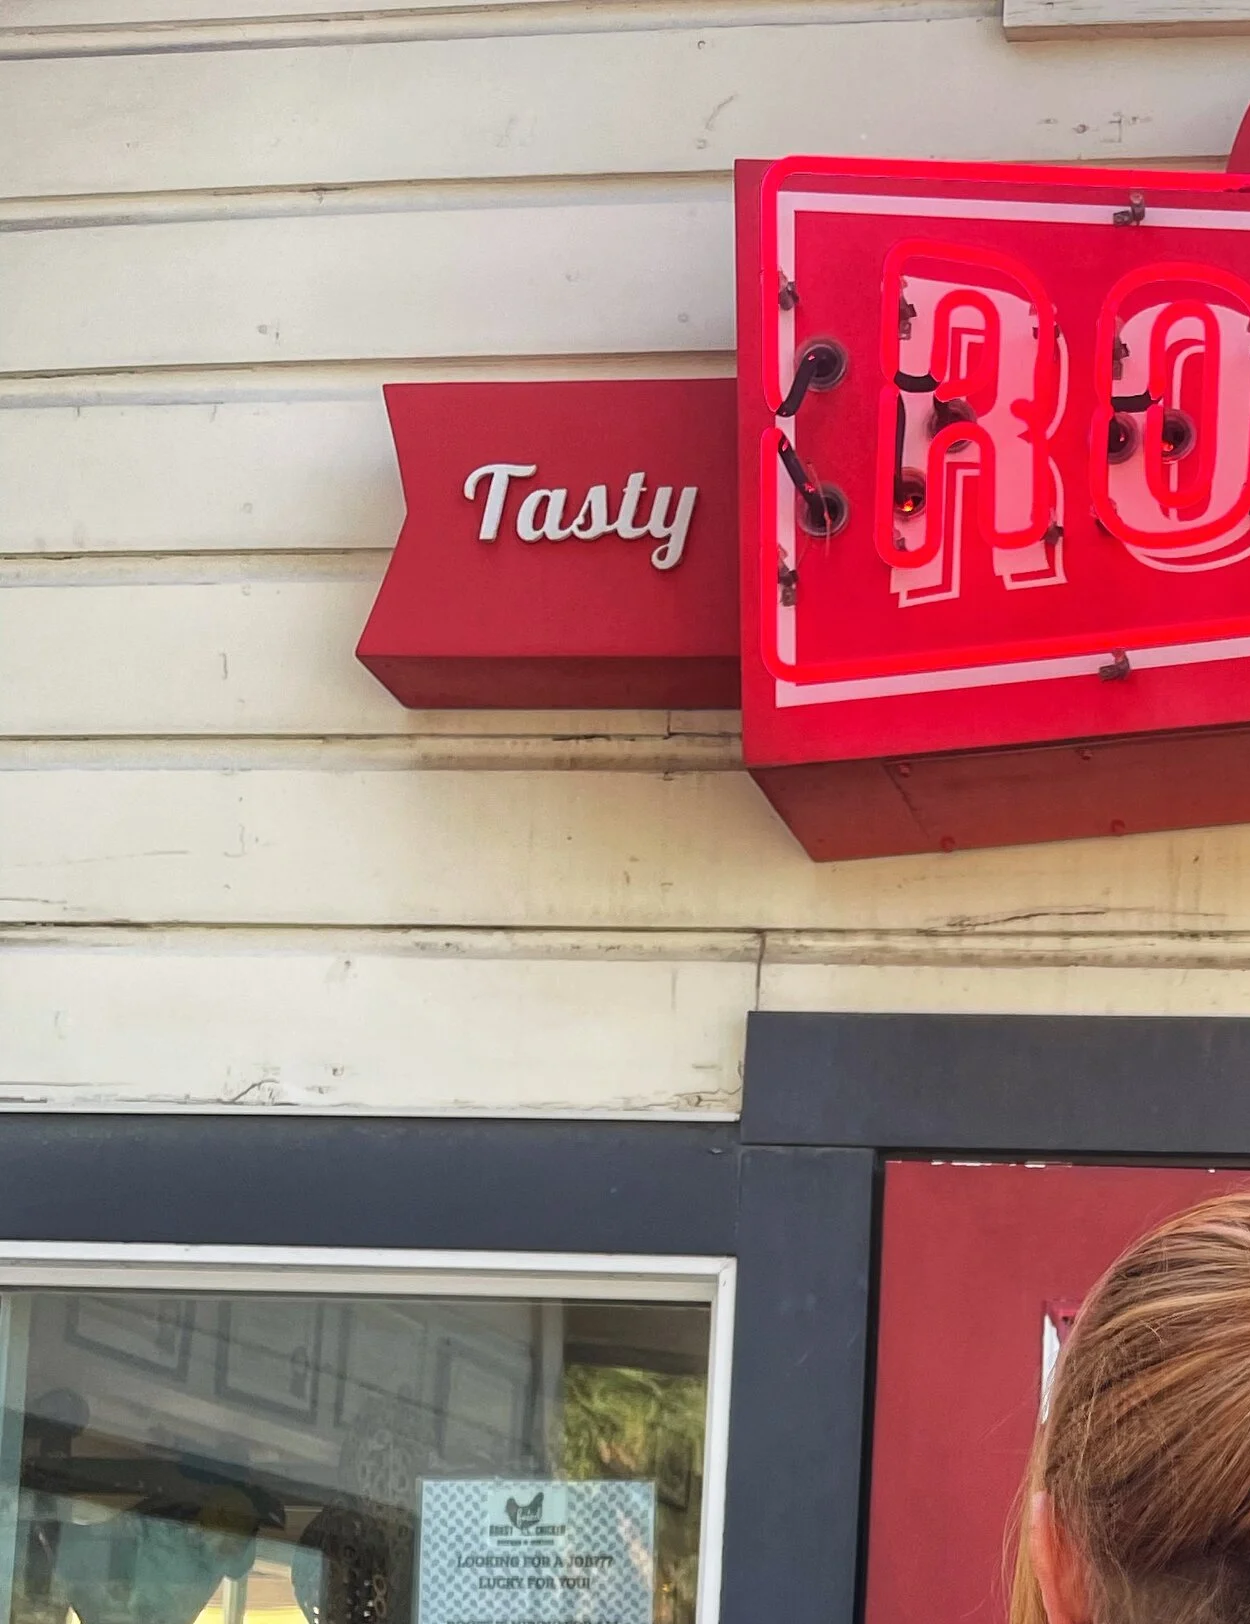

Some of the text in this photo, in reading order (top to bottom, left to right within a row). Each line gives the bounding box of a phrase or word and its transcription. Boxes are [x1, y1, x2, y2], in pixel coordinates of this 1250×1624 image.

[463, 463, 698, 570] Tasty
[457, 1556, 613, 1568] LOOKING FOR A JOB???
[478, 1577, 590, 1589] LUCKY FOR YOU!
